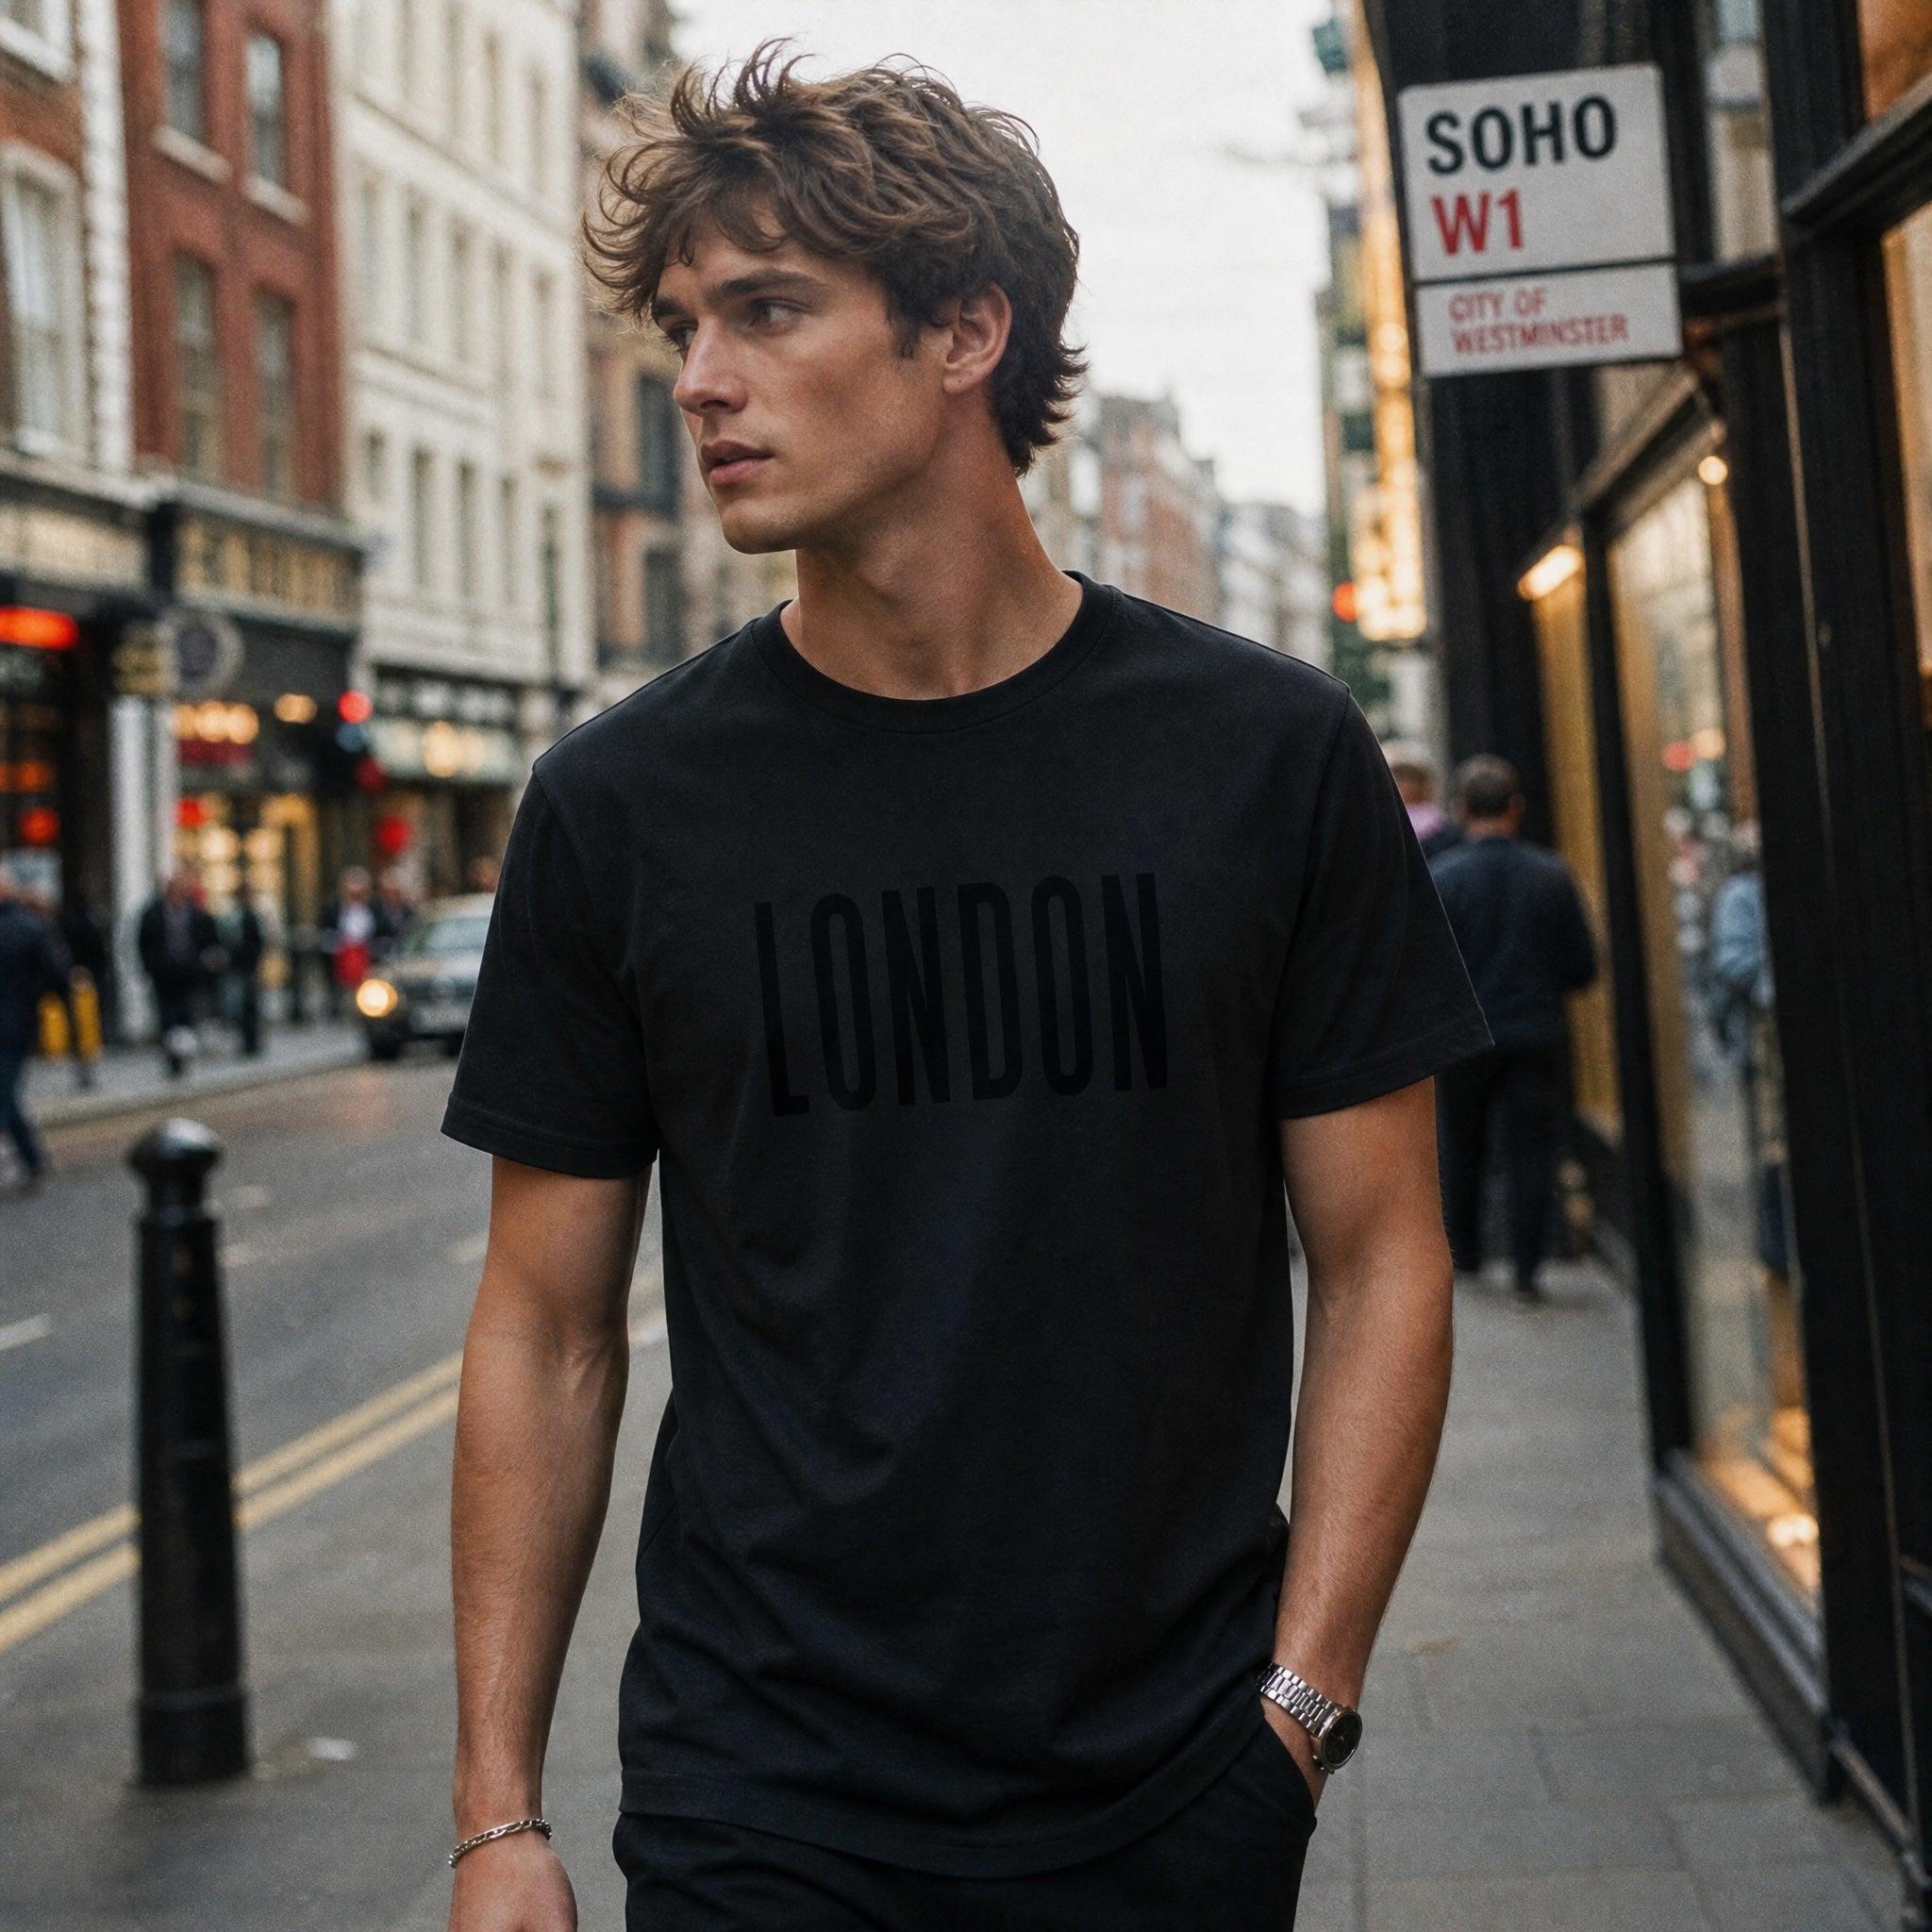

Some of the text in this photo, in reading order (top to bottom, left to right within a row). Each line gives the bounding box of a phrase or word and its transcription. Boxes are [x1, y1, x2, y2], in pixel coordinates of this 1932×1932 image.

[1425, 95, 1616, 175] SOHO
[1430, 189, 1524, 257] W1
[1449, 287, 1546, 322] CITY OF
[1453, 313, 1630, 355] WESTMINSTER
[755, 873, 1167, 1117] LONDON
